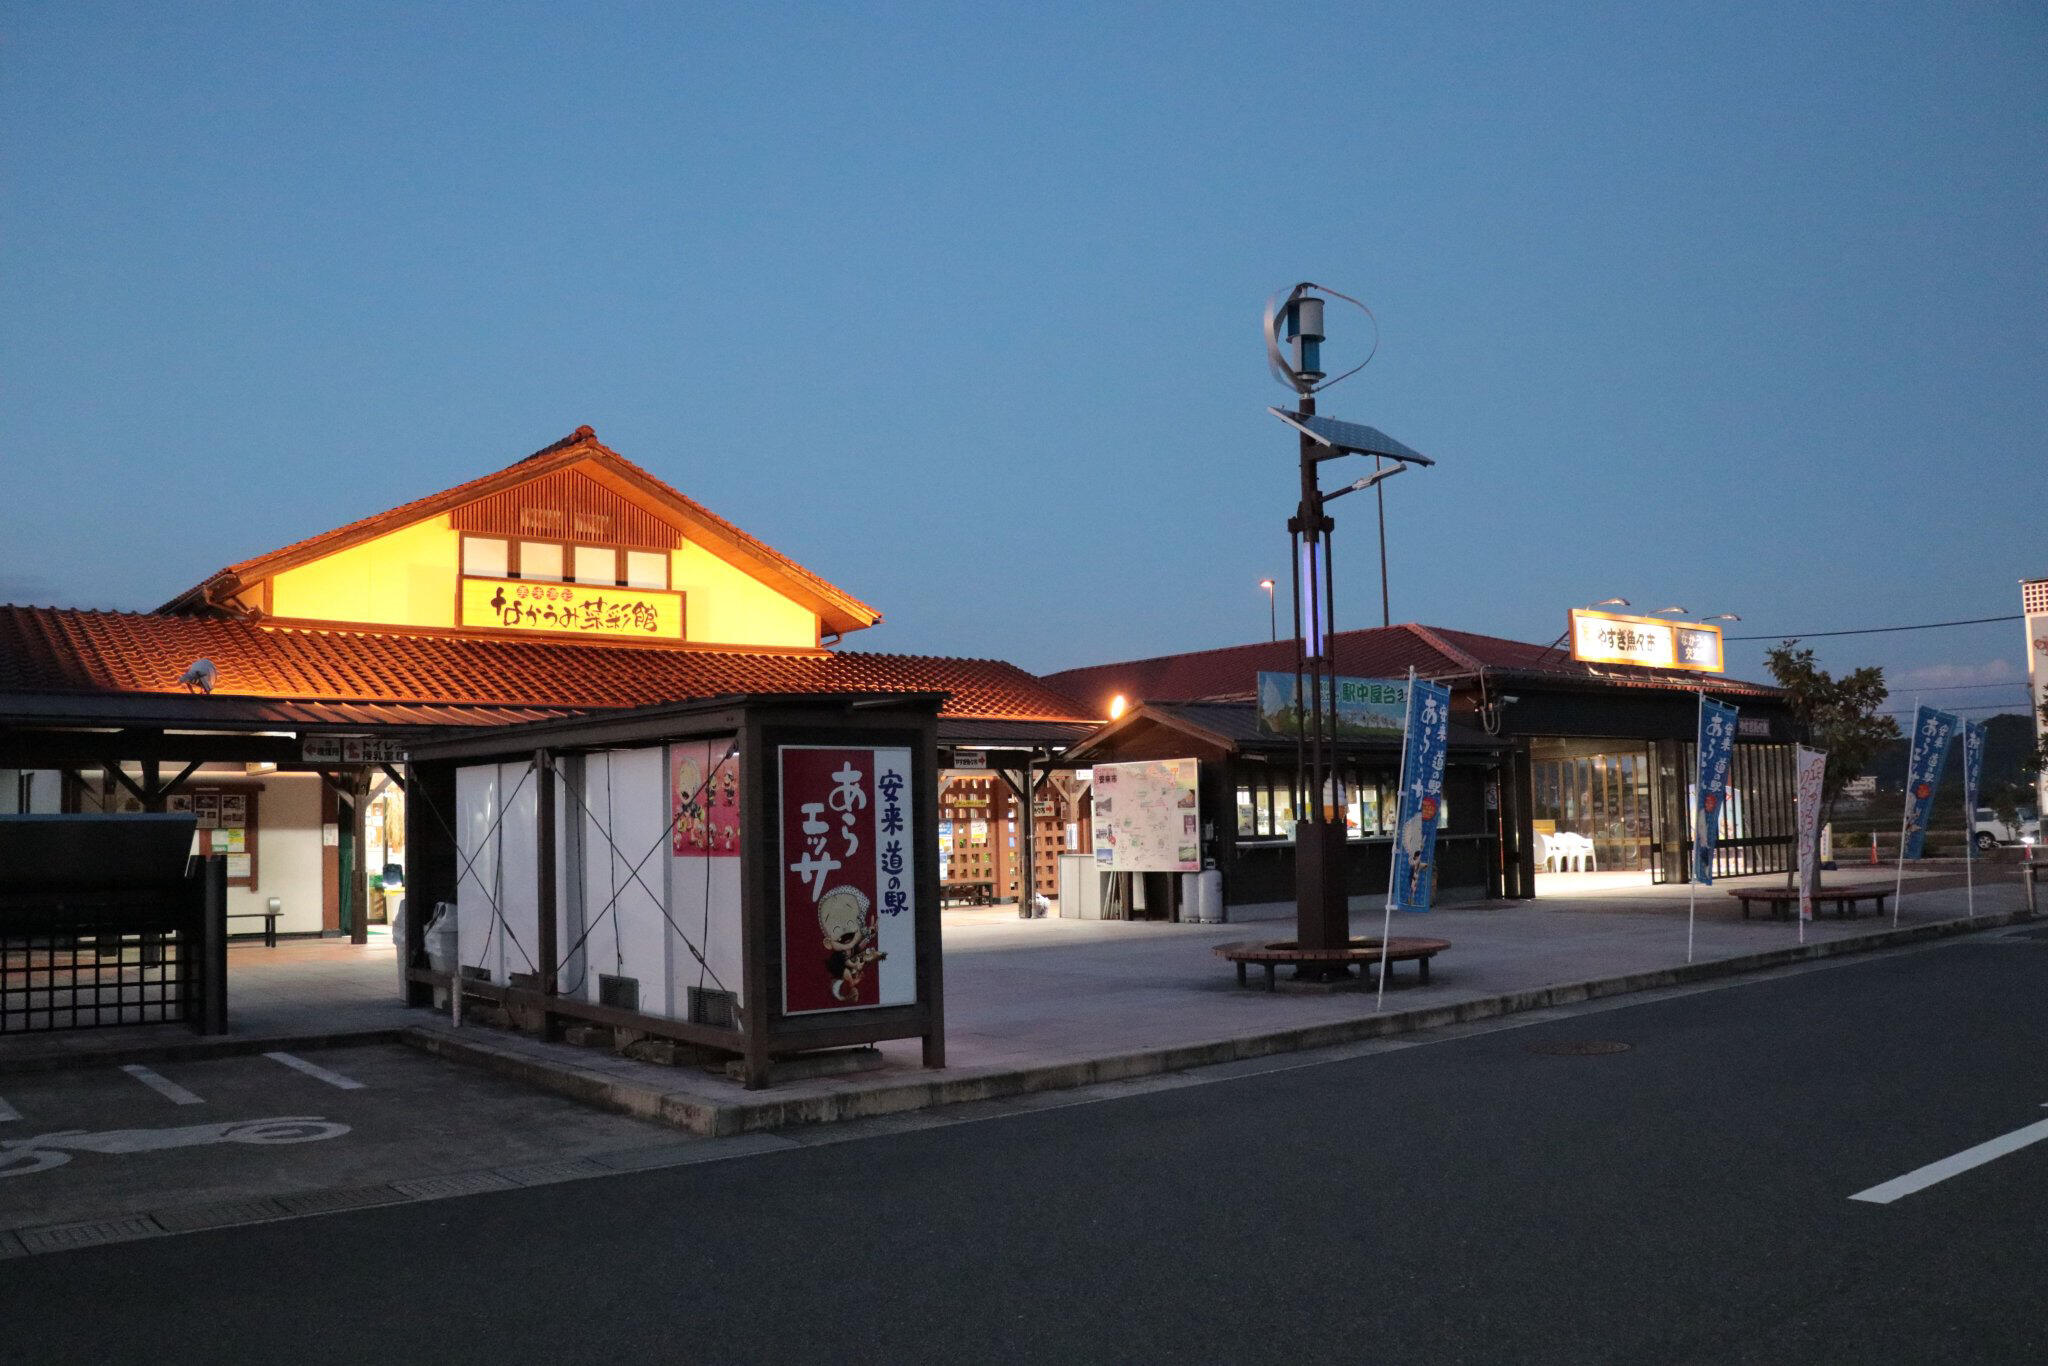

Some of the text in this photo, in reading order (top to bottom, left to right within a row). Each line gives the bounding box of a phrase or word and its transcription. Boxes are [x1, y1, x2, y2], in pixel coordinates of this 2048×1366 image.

[491, 586, 658, 632] なかうみ菜彩館
[790, 802, 842, 903] エッサ
[828, 760, 867, 858] あら
